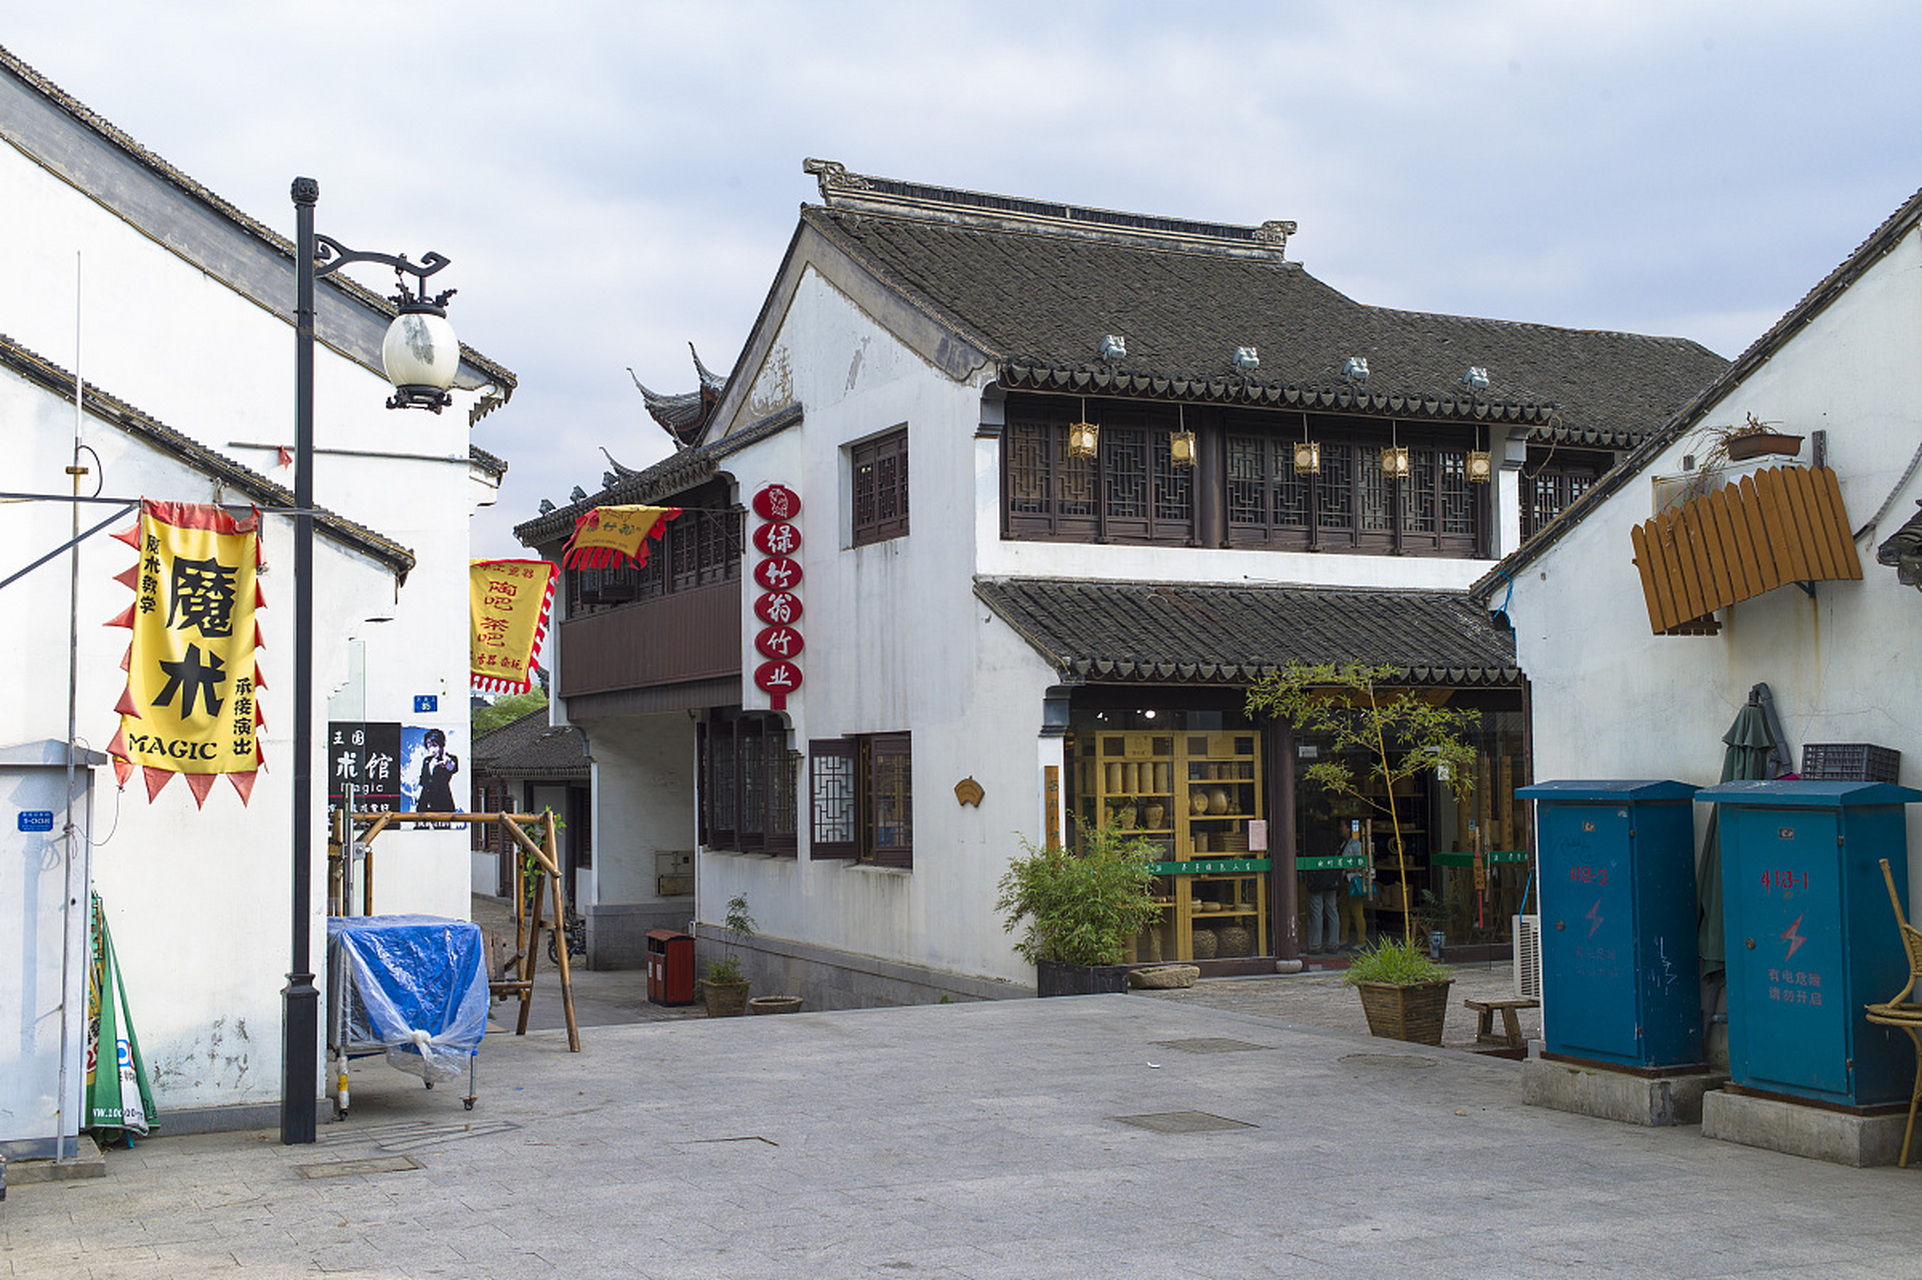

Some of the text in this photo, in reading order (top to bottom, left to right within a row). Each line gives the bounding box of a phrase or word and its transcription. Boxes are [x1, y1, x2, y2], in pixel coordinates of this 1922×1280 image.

[140, 534, 161, 615] 魔术教学
[766, 524, 794, 687] 绿竹翁竹业
[151, 556, 239, 720] 魔术
[233, 677, 253, 756] 承接演出
[128, 733, 218, 761] MAGIC
[336, 751, 393, 780] 术馆
[1569, 866, 1608, 885] 418-2
[1761, 869, 1809, 891] 418-1
[1768, 968, 1821, 987] 有电危险
[1769, 986, 1822, 1006] 请勿开启
